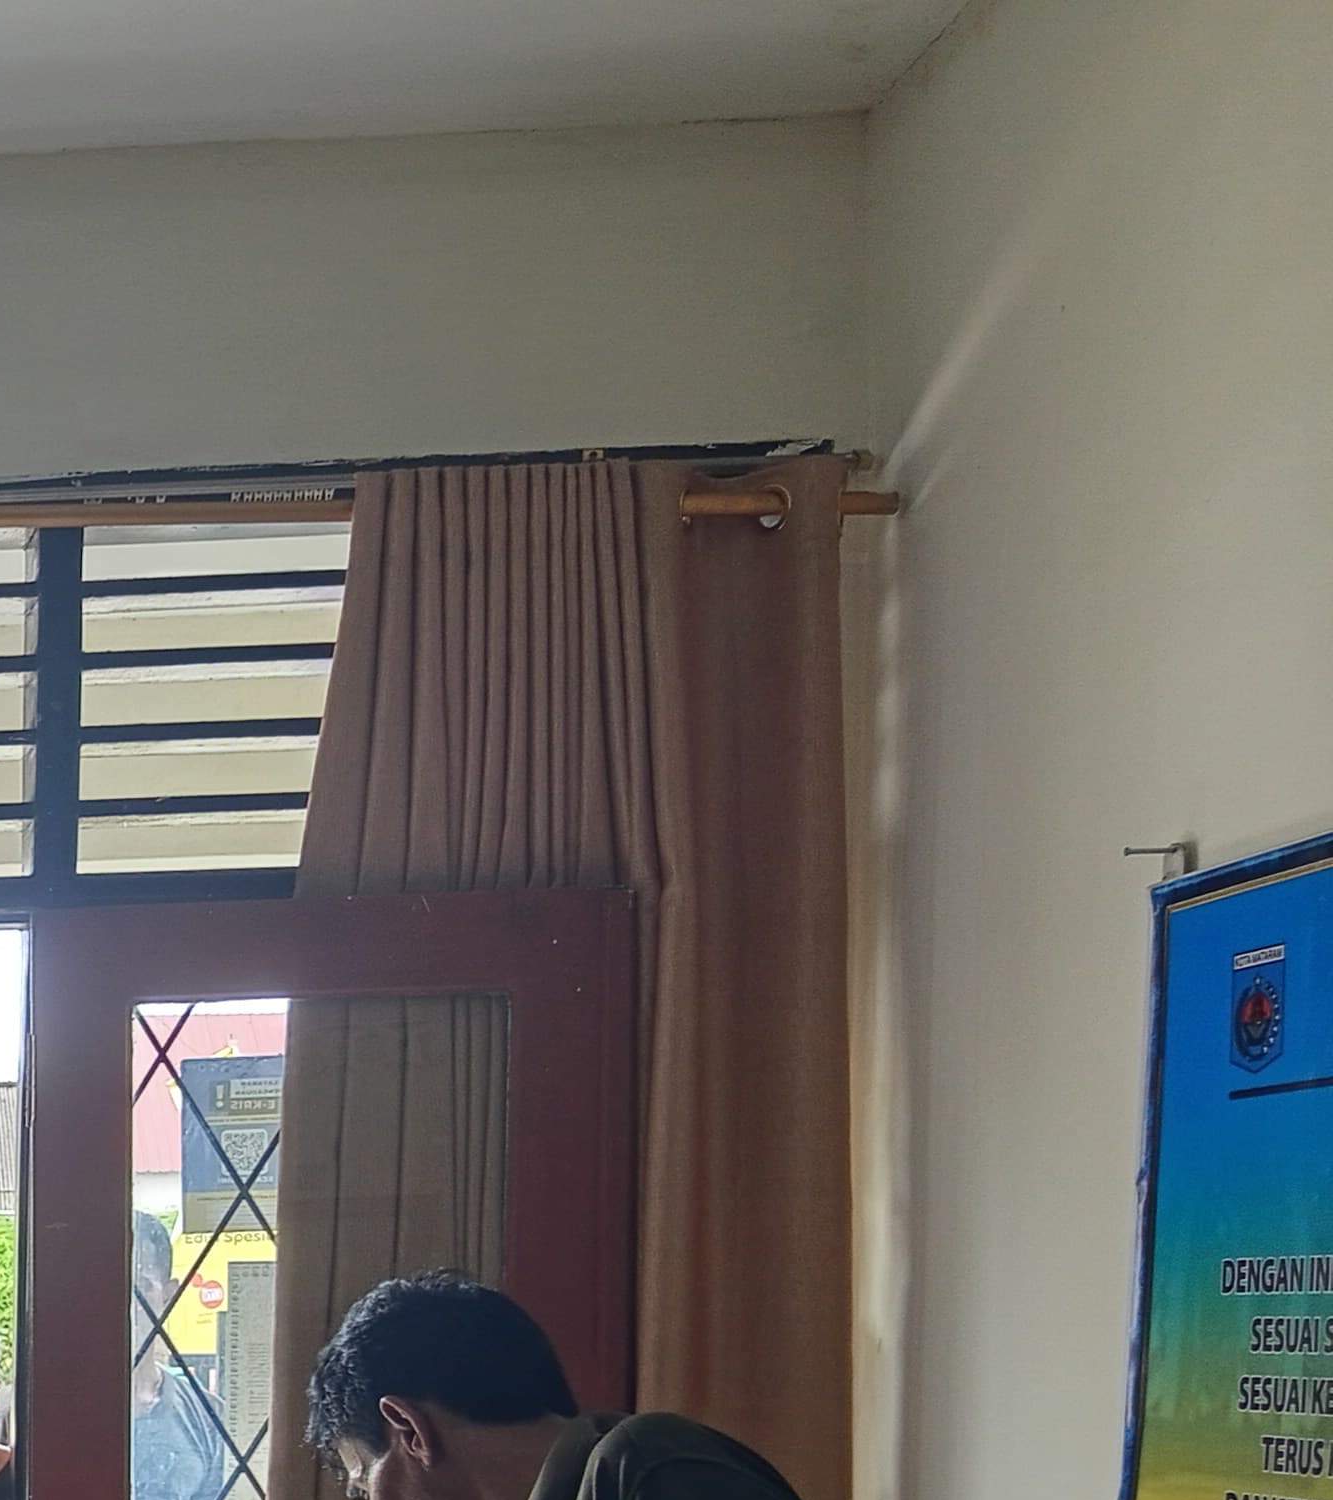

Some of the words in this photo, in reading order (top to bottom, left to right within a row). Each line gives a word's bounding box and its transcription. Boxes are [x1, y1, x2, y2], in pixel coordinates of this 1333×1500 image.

[1222, 1257, 1304, 1294] DENGAN
[1309, 1256, 1333, 1293] IN
[1251, 1317, 1320, 1354] SESUAI
[1238, 1375, 1306, 1412] SESUAI
[1262, 1436, 1324, 1475] TERUS
